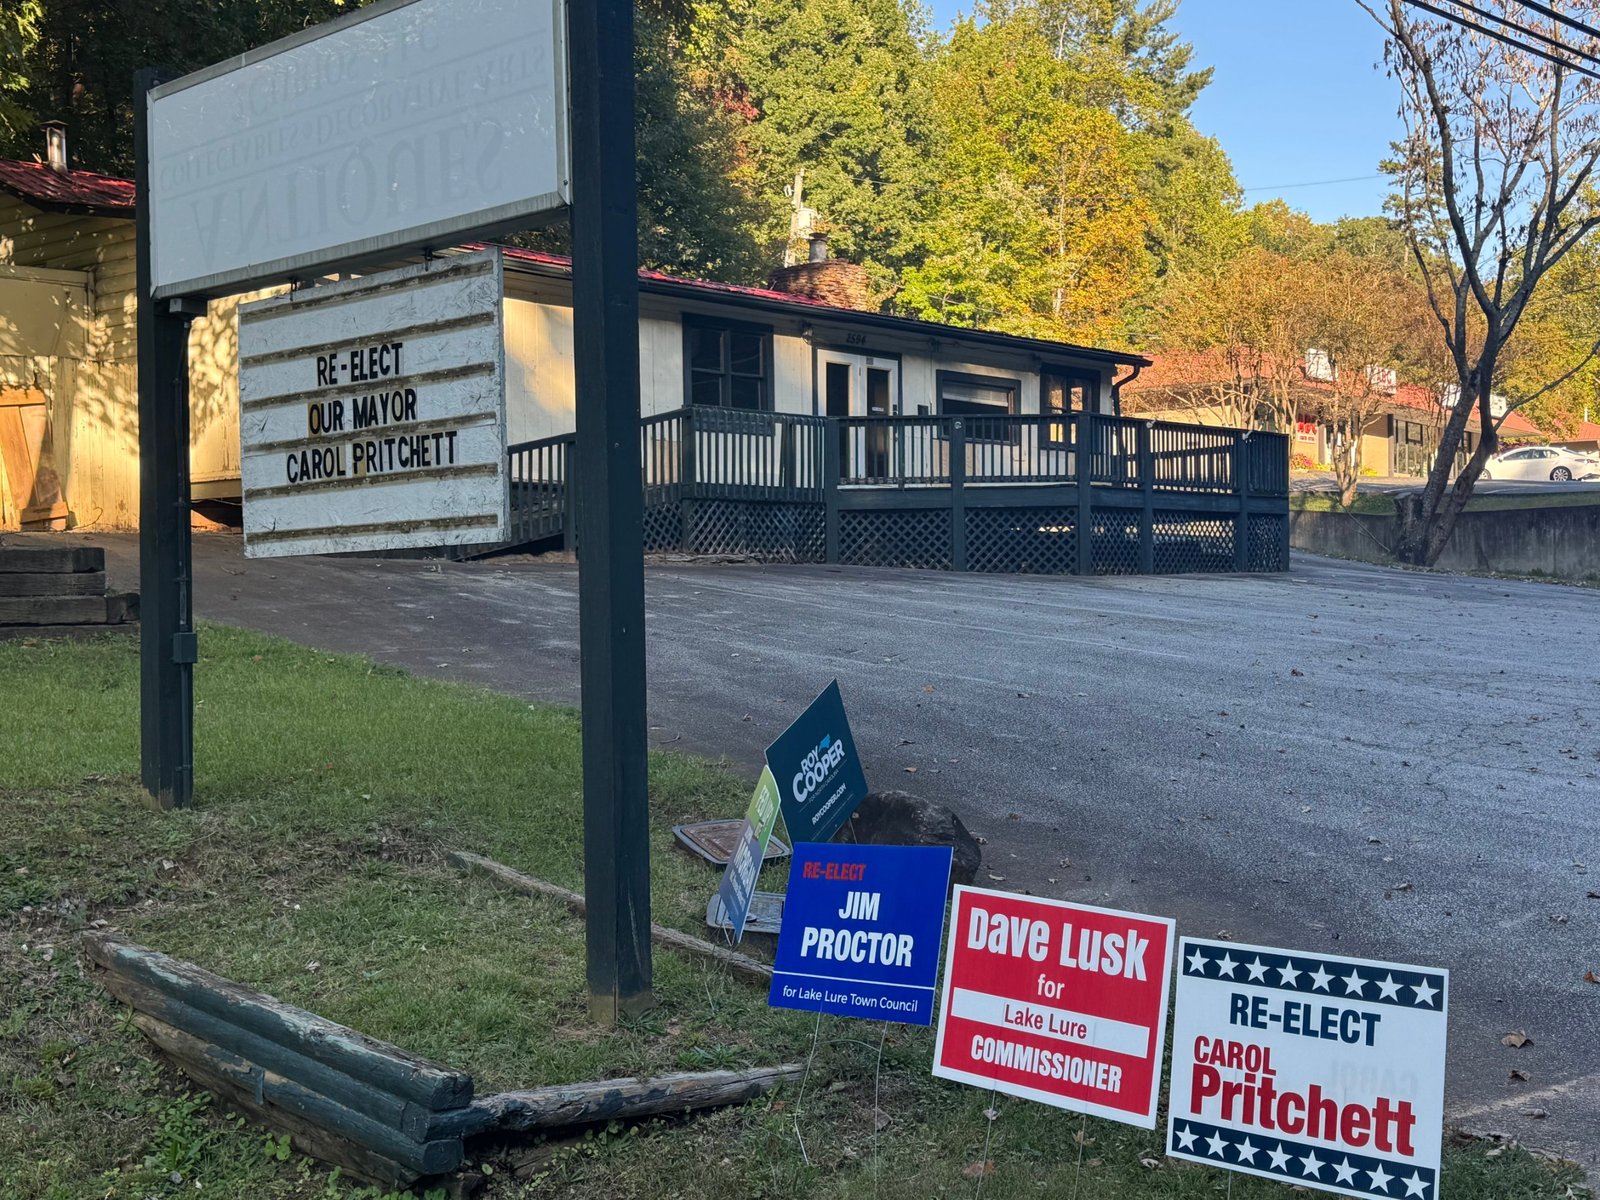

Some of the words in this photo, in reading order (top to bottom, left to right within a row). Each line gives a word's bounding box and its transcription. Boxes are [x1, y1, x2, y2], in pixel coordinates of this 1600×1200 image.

[316, 342, 403, 387] RE-ELECT
[309, 400, 344, 435] OUR
[352, 388, 417, 430] MAYOR
[286, 446, 346, 483] CAROL
[352, 430, 457, 475] PRITCHETT
[792, 739, 845, 803] COOPER
[800, 745, 819, 776] ROY
[811, 782, 847, 825] ROYCOOPER.COM
[802, 861, 867, 881] RE-ELECT
[838, 891, 881, 921] JIM
[800, 926, 914, 967] PROCTOR
[967, 906, 1050, 962] Dave
[782, 985, 797, 997] for
[798, 987, 822, 1001] Lake
[824, 990, 848, 1004] Lure
[850, 993, 877, 1008] Town
[879, 996, 918, 1012] Council
[1037, 973, 1065, 999] for
[1004, 1003, 1044, 1030] Lake
[1049, 1013, 1087, 1039] Lure
[1229, 992, 1381, 1047] RE-ELECT
[970, 1034, 1123, 1093] COMMISSIONER
[1193, 1035, 1277, 1076] CAROL
[1190, 1062, 1416, 1157] Pritchett
